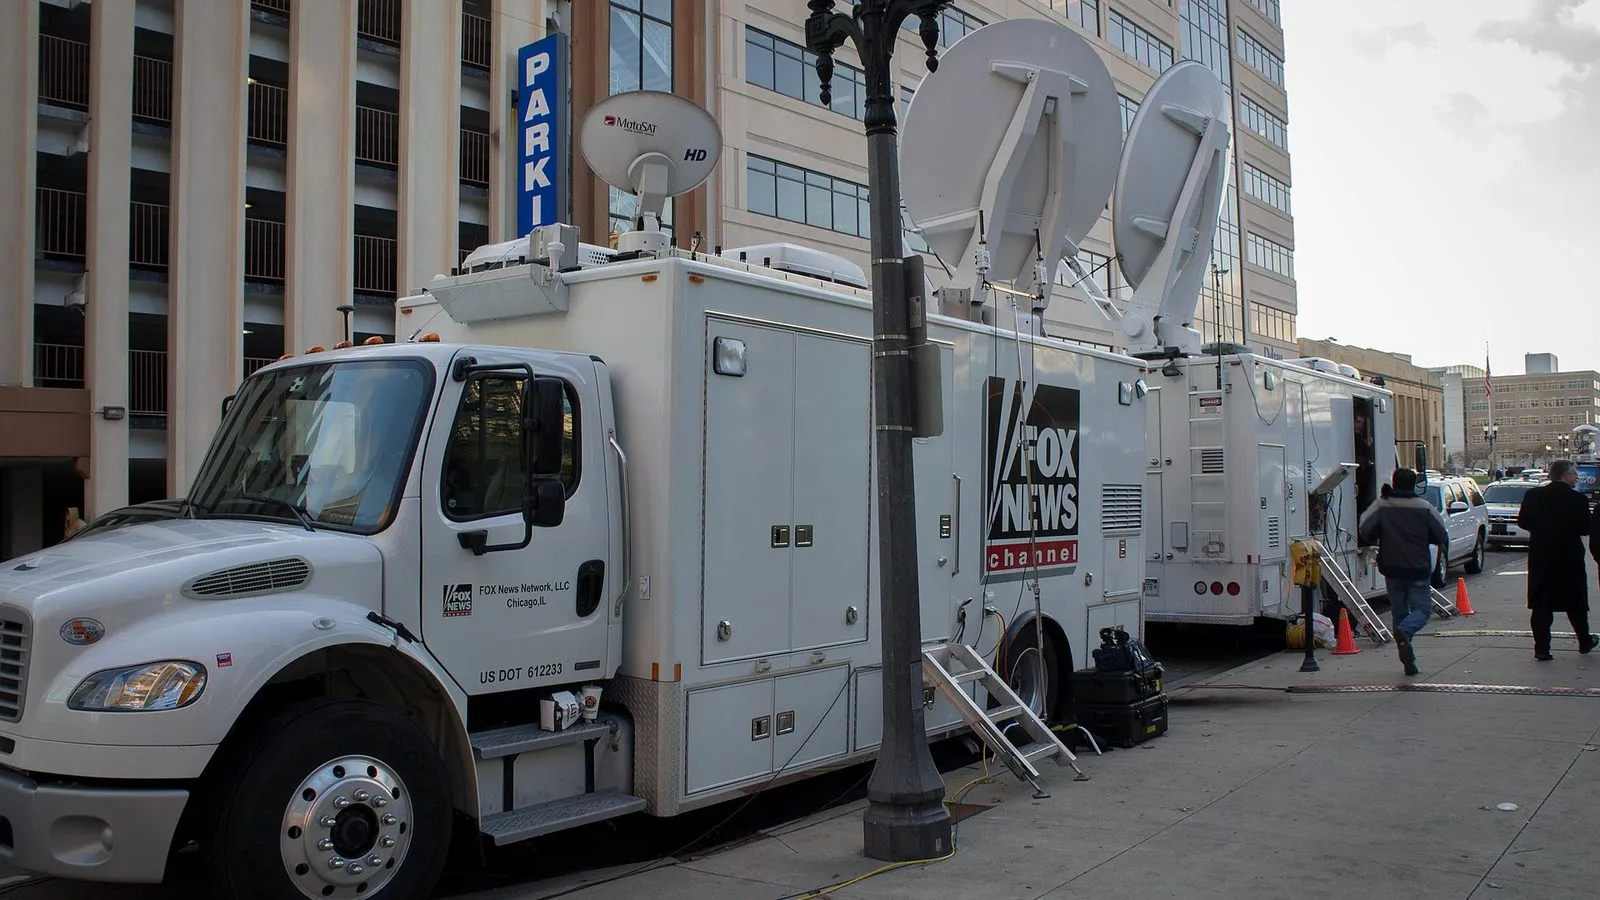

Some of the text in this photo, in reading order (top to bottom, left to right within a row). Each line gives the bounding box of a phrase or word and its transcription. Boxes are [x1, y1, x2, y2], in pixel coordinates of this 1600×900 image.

[616, 117, 658, 134] MotoSAT
[524, 52, 551, 238] PARKI
[684, 149, 707, 161] HD
[1020, 424, 1077, 478] FOX
[1002, 483, 1077, 532] NEWS
[989, 543, 1077, 568] channel
[452, 591, 471, 602] FOX
[479, 581, 570, 595] FOX News Network, LLC
[447, 601, 471, 611] NEWS
[480, 670, 496, 684] US
[499, 667, 523, 682] DOT
[527, 662, 563, 678] 612233
